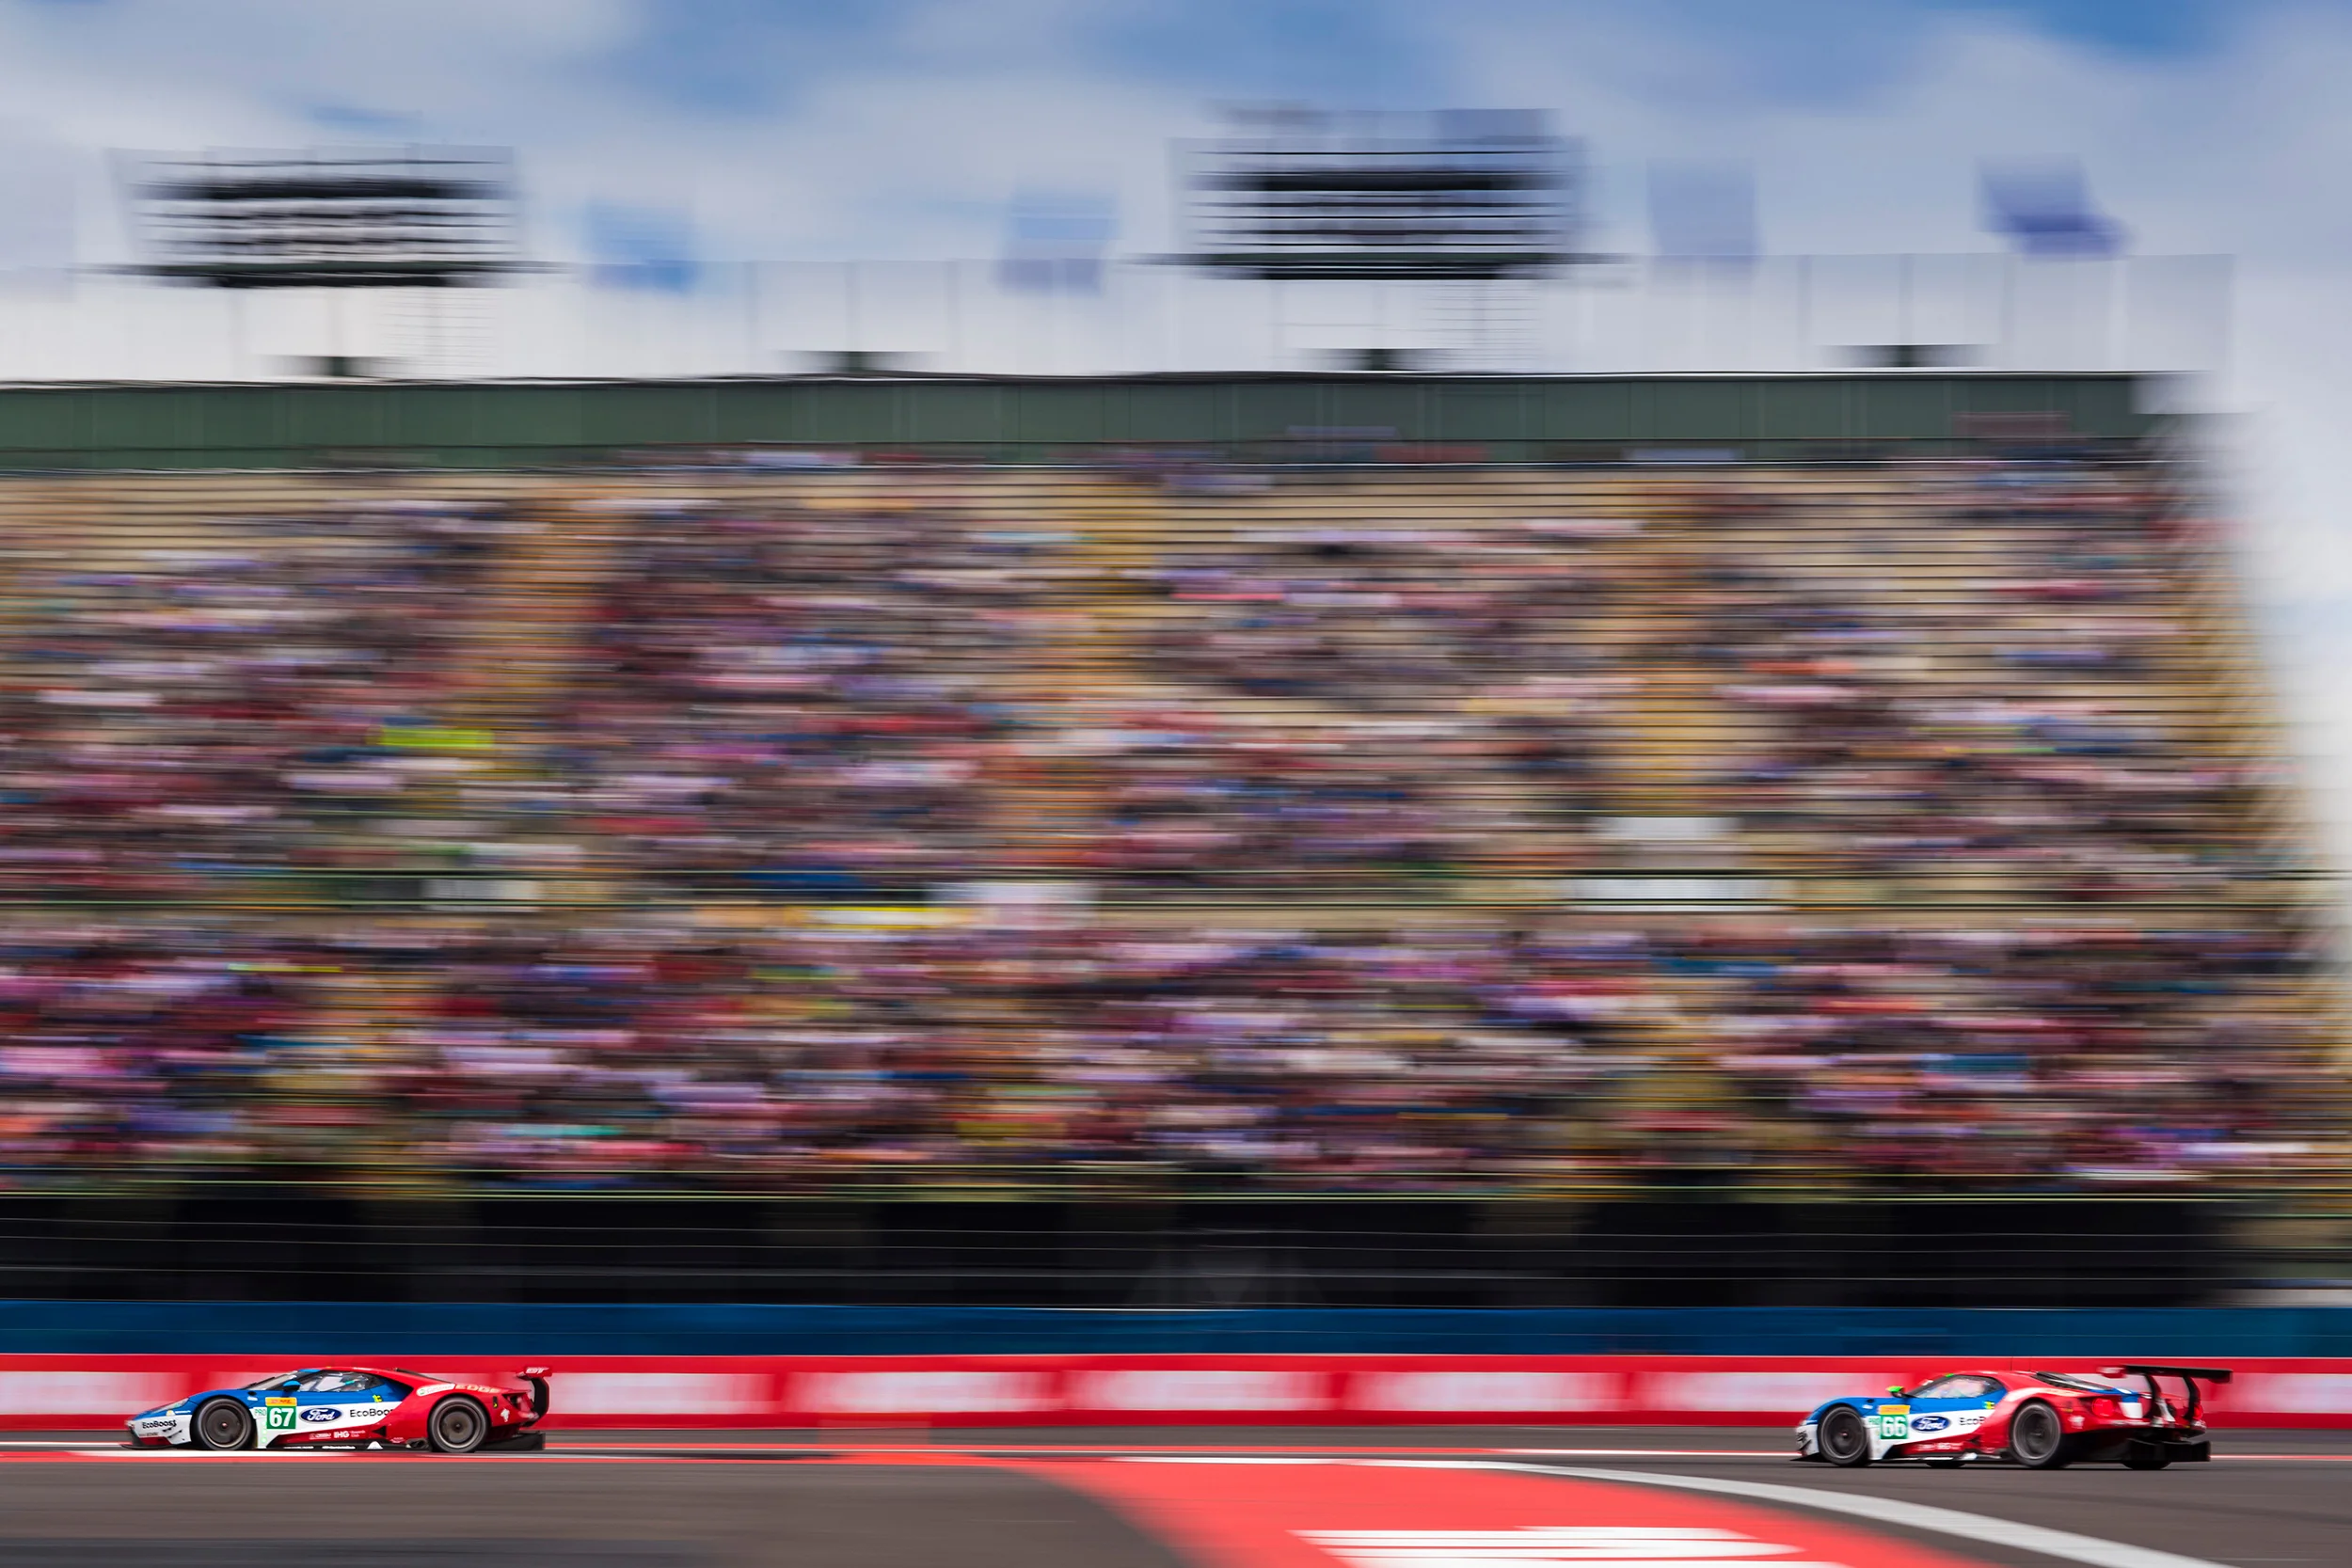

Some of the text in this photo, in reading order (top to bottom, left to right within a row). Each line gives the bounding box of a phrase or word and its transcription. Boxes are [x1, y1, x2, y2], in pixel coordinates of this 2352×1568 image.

[269, 1407, 294, 1427] 67
[307, 1409, 336, 1421] Ford
[142, 1419, 177, 1429] EcoBoost
[1882, 1416, 1907, 1437] 66
[1916, 1417, 1947, 1431] Ford
[334, 1431, 349, 1439] IHG
